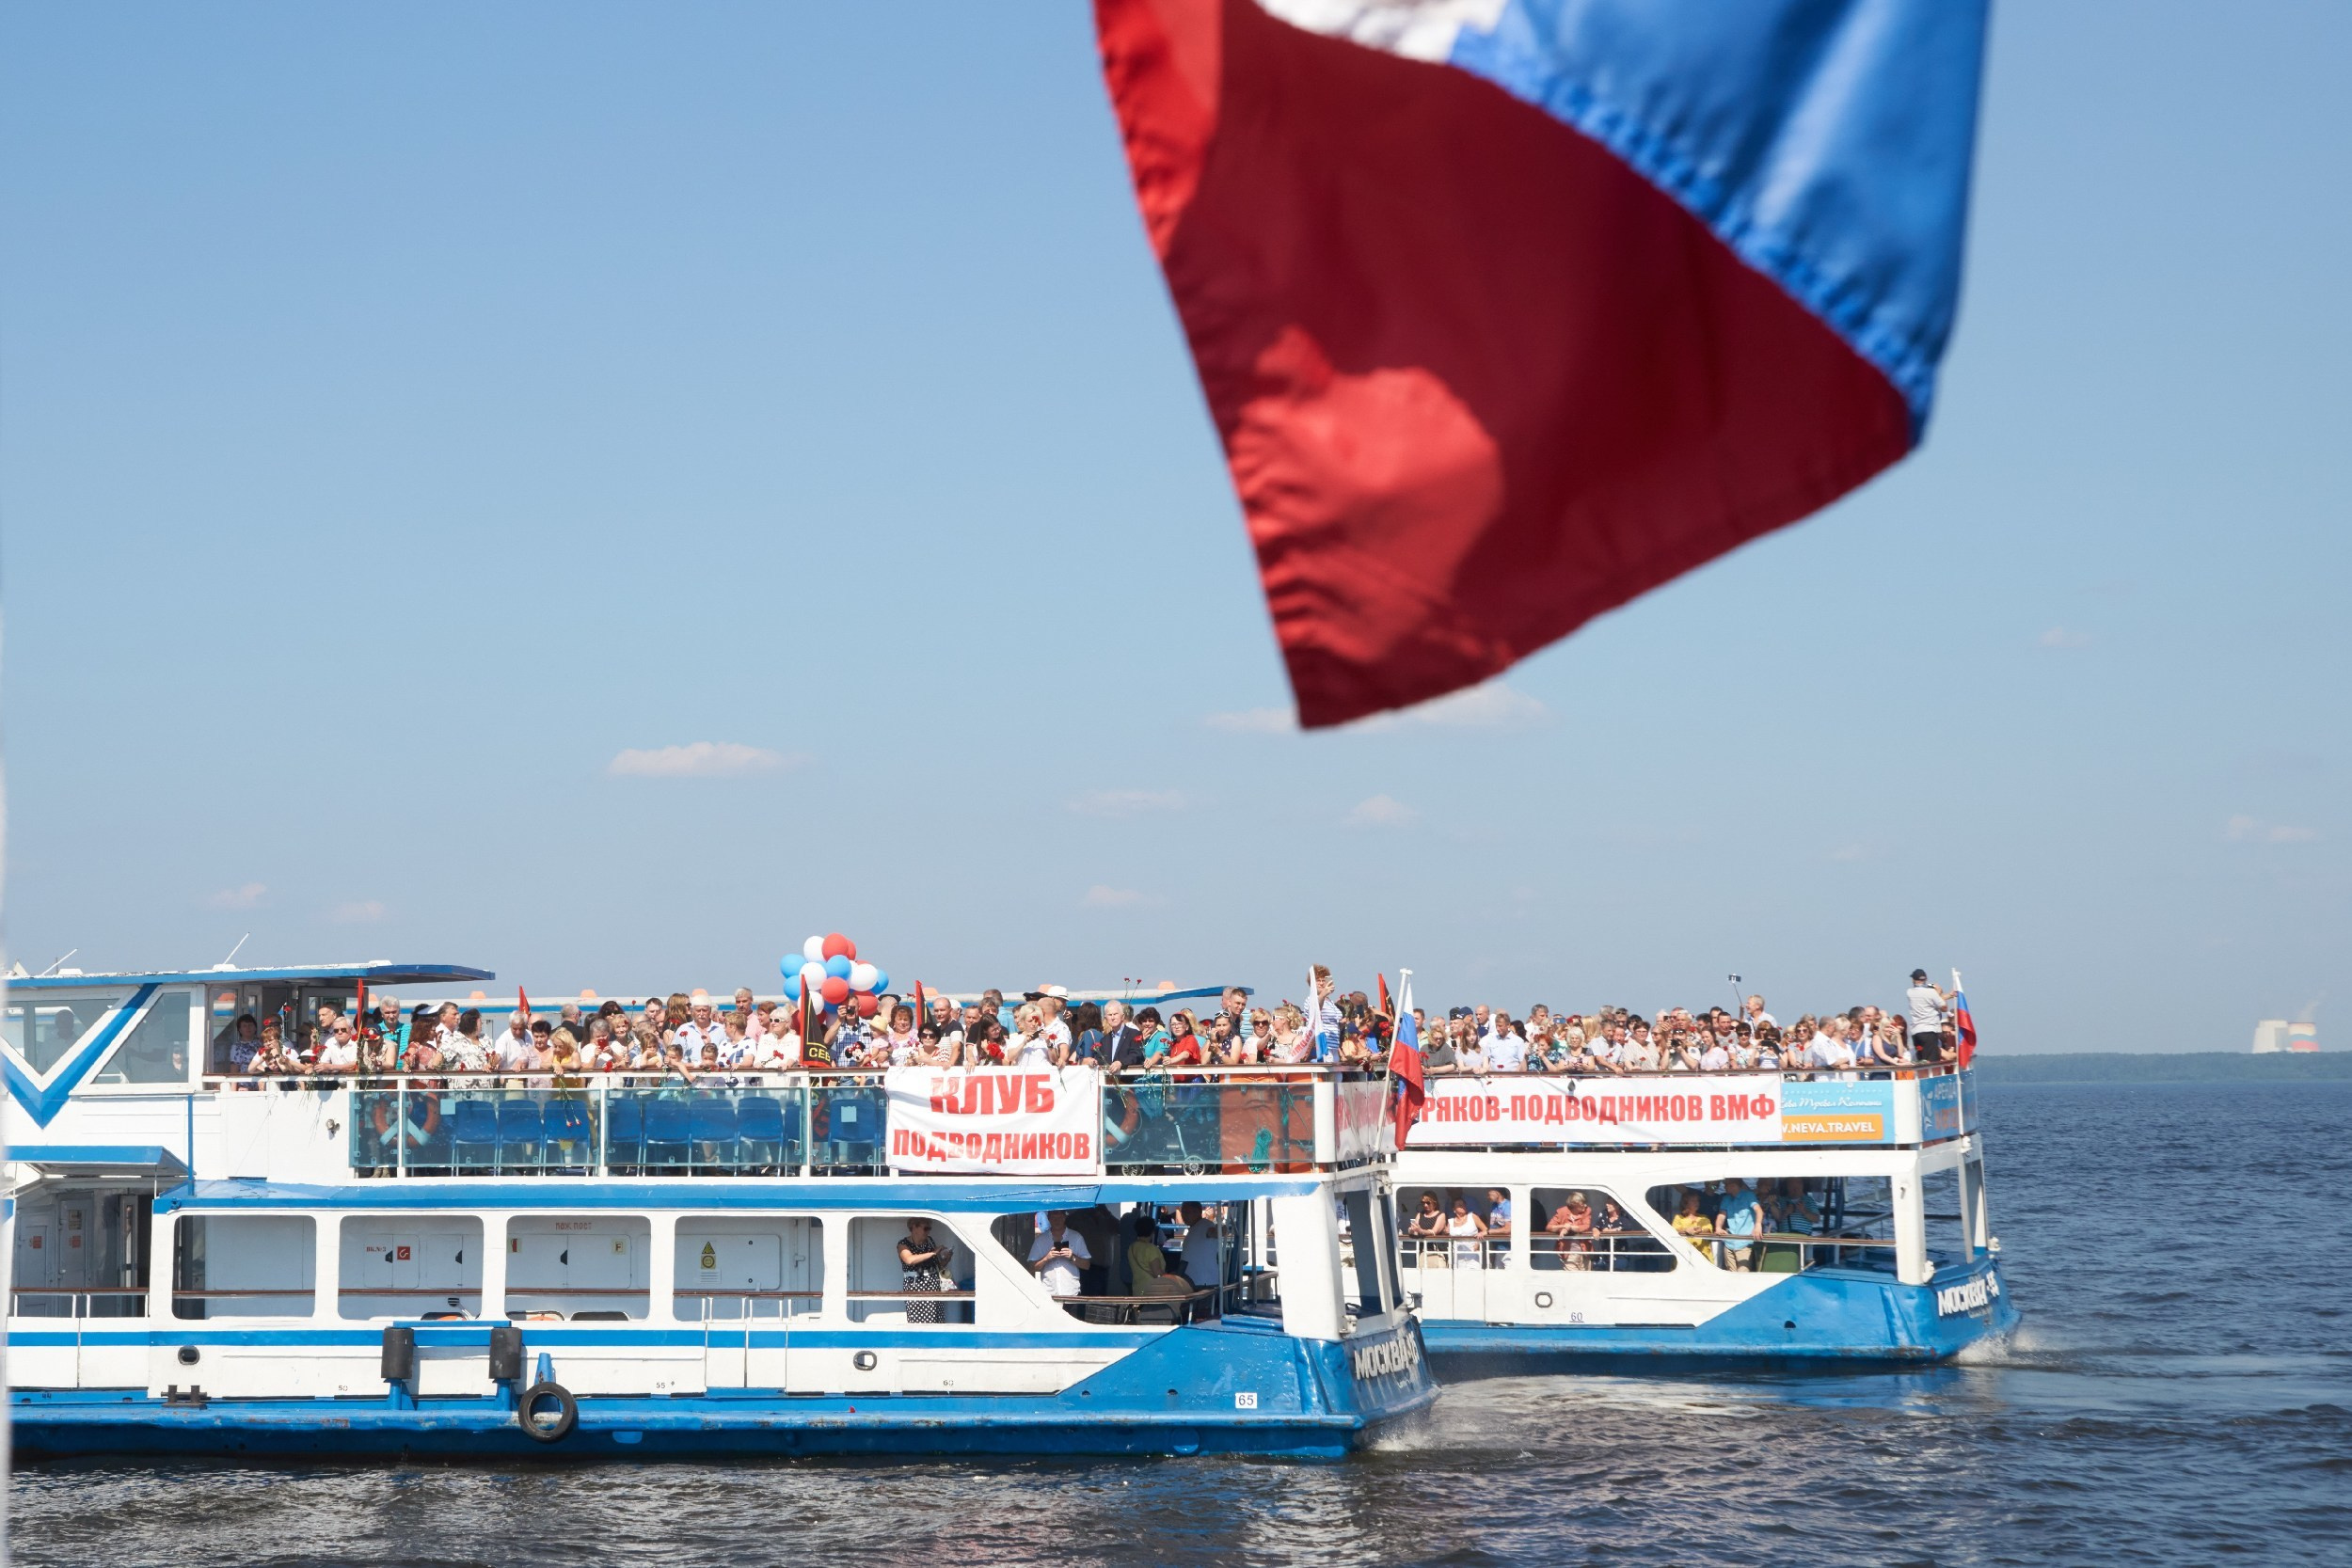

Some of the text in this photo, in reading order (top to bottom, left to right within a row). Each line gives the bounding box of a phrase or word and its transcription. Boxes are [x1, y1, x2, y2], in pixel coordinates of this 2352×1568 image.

[930, 1074, 1055, 1115] КЛУБ
[1710, 1094, 1775, 1121] ВМФ
[894, 1129, 1090, 1164] ПОДВОДНИКОВ
[1570, 1311, 1583, 1322] 60
[1238, 1394, 1254, 1406] 65
